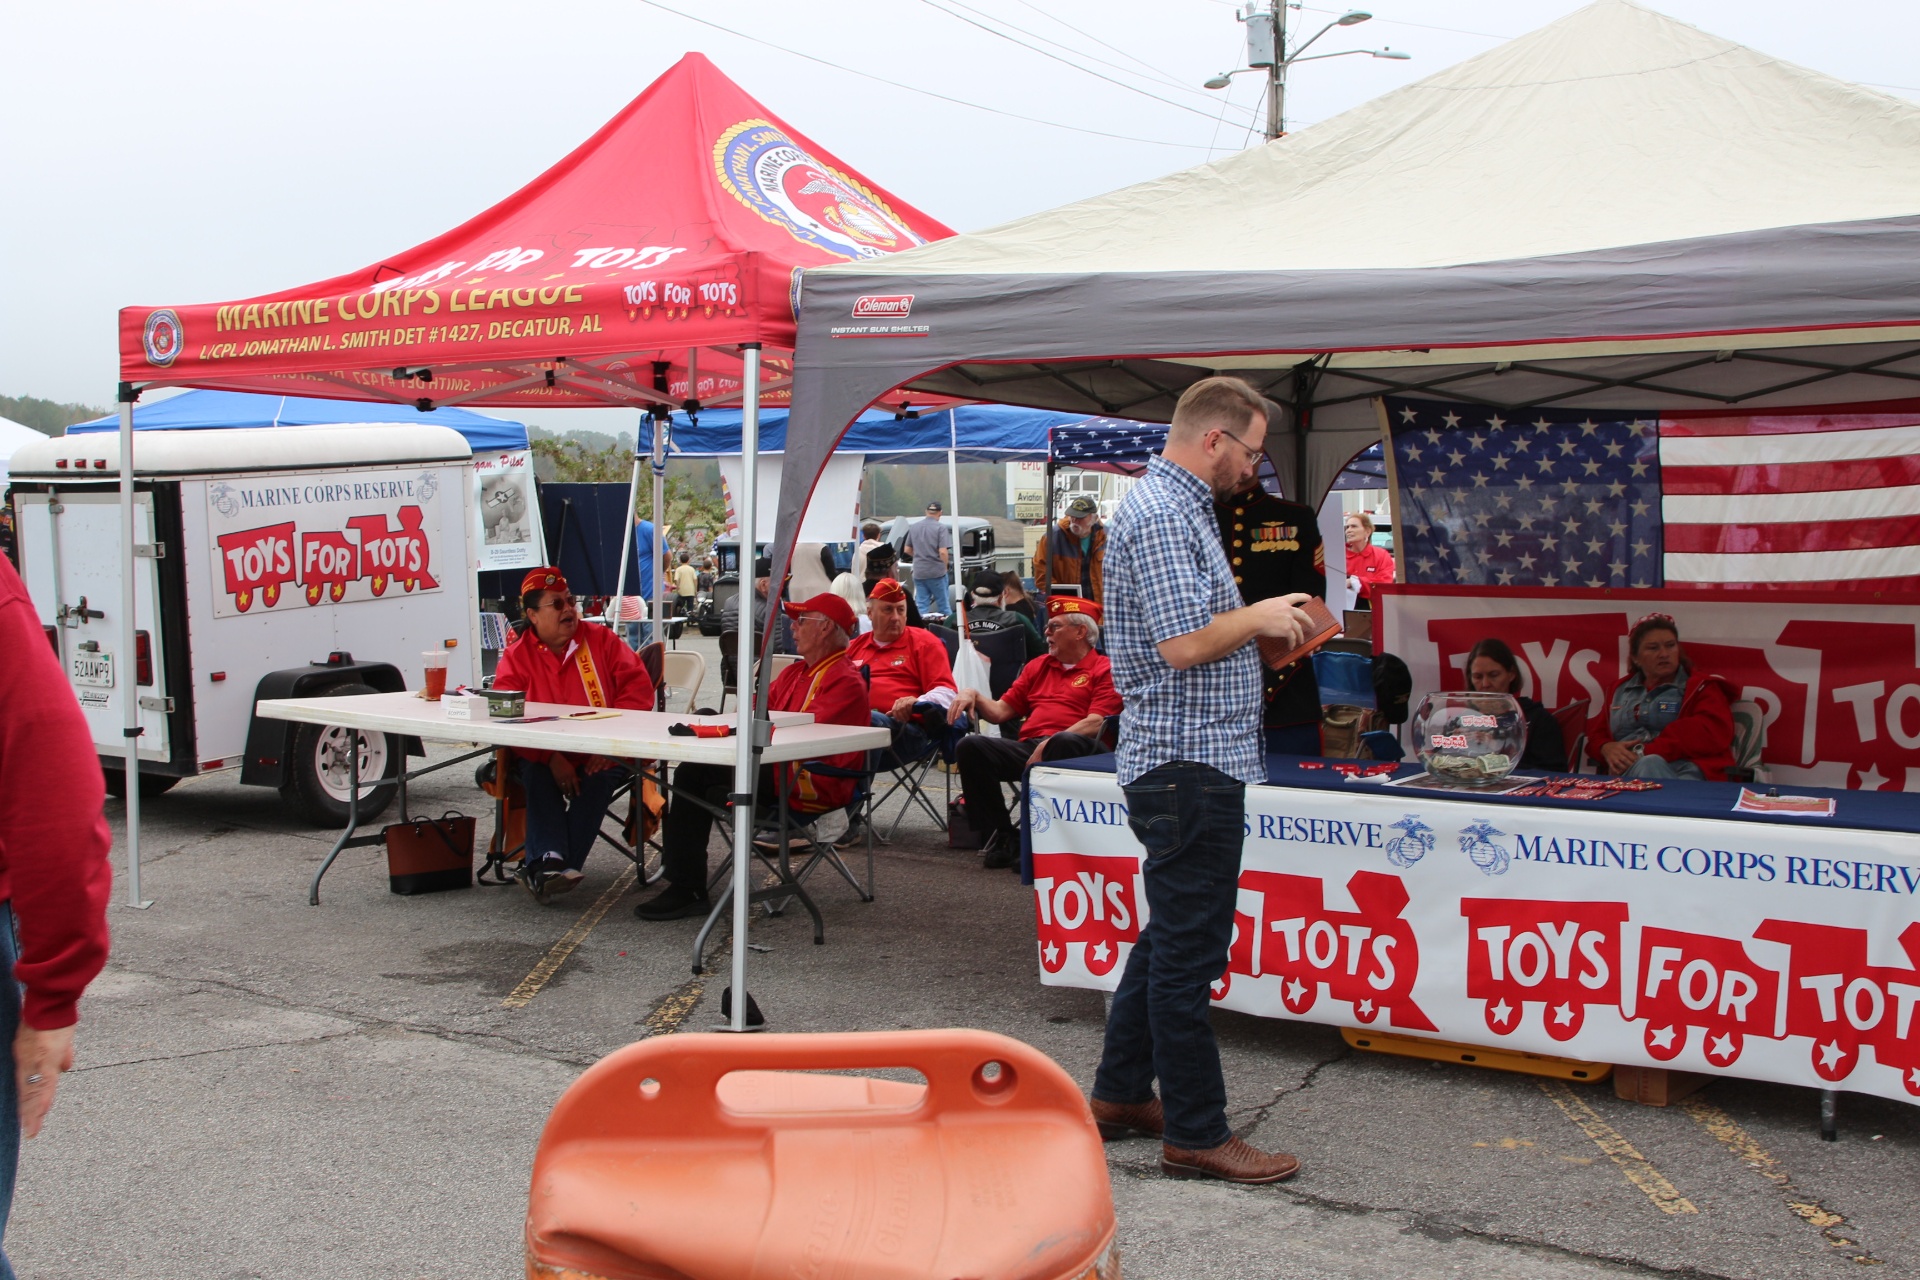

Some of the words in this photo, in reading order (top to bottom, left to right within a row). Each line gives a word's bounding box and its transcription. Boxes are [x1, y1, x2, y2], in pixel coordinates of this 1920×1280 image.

[759, 155, 784, 193] MARINE
[570, 246, 686, 270] TOTS
[216, 299, 330, 332] MARINE
[338, 289, 440, 321] CORPS
[451, 282, 596, 312] LEAGUE
[624, 280, 657, 305] TOYS
[664, 282, 691, 306] FOR
[699, 282, 738, 305] TOTS
[857, 298, 900, 312] Coleman
[199, 342, 239, 360] L/CPL
[240, 336, 321, 356] JONATHAN
[321, 335, 335, 351] L.
[340, 330, 390, 349] SMITH
[393, 327, 425, 346] DET
[428, 324, 484, 344] #1427,
[487, 317, 576, 340] DECATUR,
[579, 314, 603, 333] AL
[831, 326, 868, 334] INSTANT
[891, 325, 930, 333] SHELTER
[500, 454, 524, 468] Pilot
[240, 486, 301, 509] MARINE
[304, 483, 351, 504] CORPS
[354, 480, 414, 501] RESERVE
[1018, 492, 1042, 502] Aviation
[226, 536, 291, 582] TOYS
[305, 540, 351, 577] FOR
[365, 536, 422, 572] TOTS
[968, 621, 981, 630] U.S.
[982, 621, 1000, 631] NAVY
[74, 660, 110, 679] 52AAWP9
[580, 654, 592, 674] US
[1449, 638, 1605, 719] YS
[1051, 797, 1130, 826] MARI
[1258, 813, 1384, 849] RESERVE
[1514, 834, 1648, 871] MARINE
[1657, 845, 1776, 882] CORPS
[1784, 856, 1920, 895] RESERV
[1034, 871, 1131, 931] TOYS
[1271, 916, 1398, 991] TOTS
[1477, 920, 1610, 989] TOYS
[1644, 946, 1759, 1022] FOR
